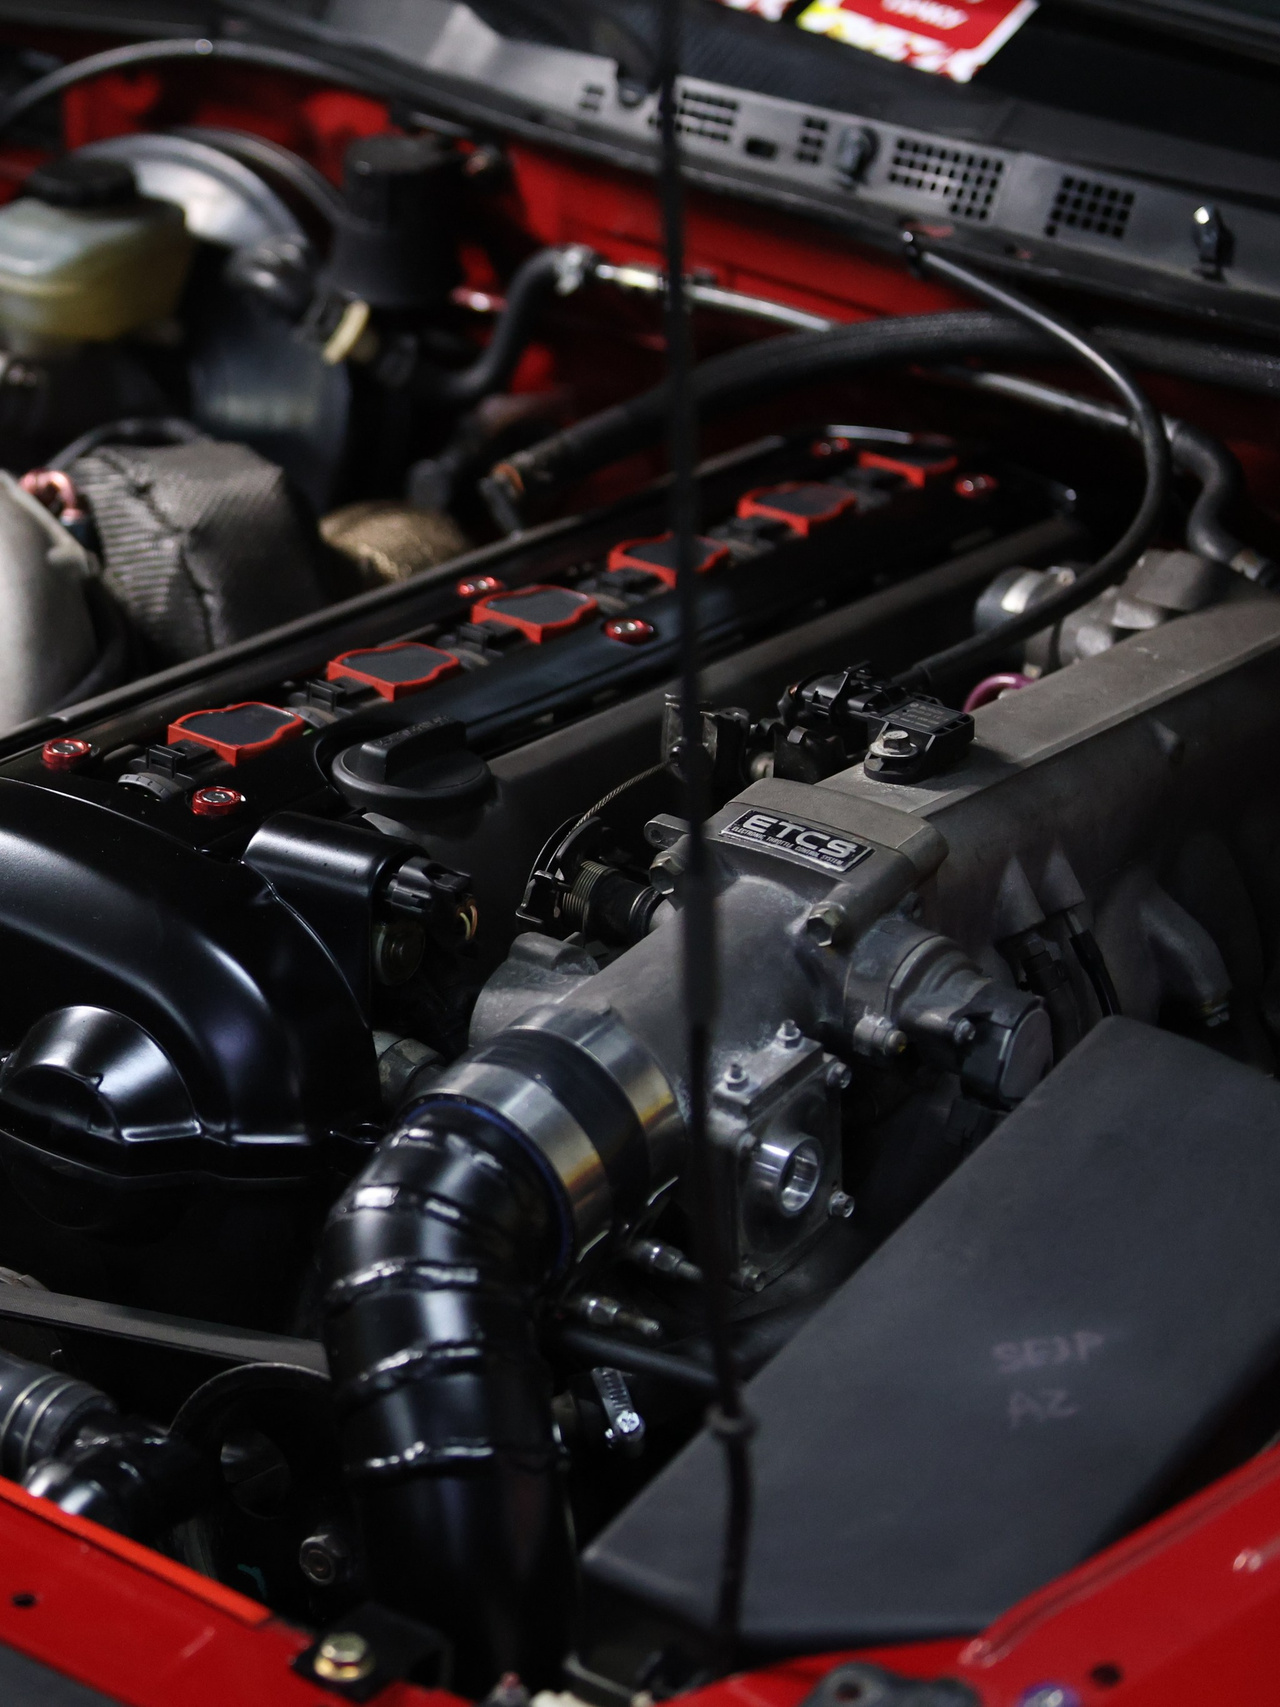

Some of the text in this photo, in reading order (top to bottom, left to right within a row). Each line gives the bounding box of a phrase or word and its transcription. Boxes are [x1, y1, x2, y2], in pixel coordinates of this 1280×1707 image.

[731, 825, 845, 866] ELECTRONIC THROTTLE CONTROL SYSTEM
[742, 813, 858, 860] ETCS
